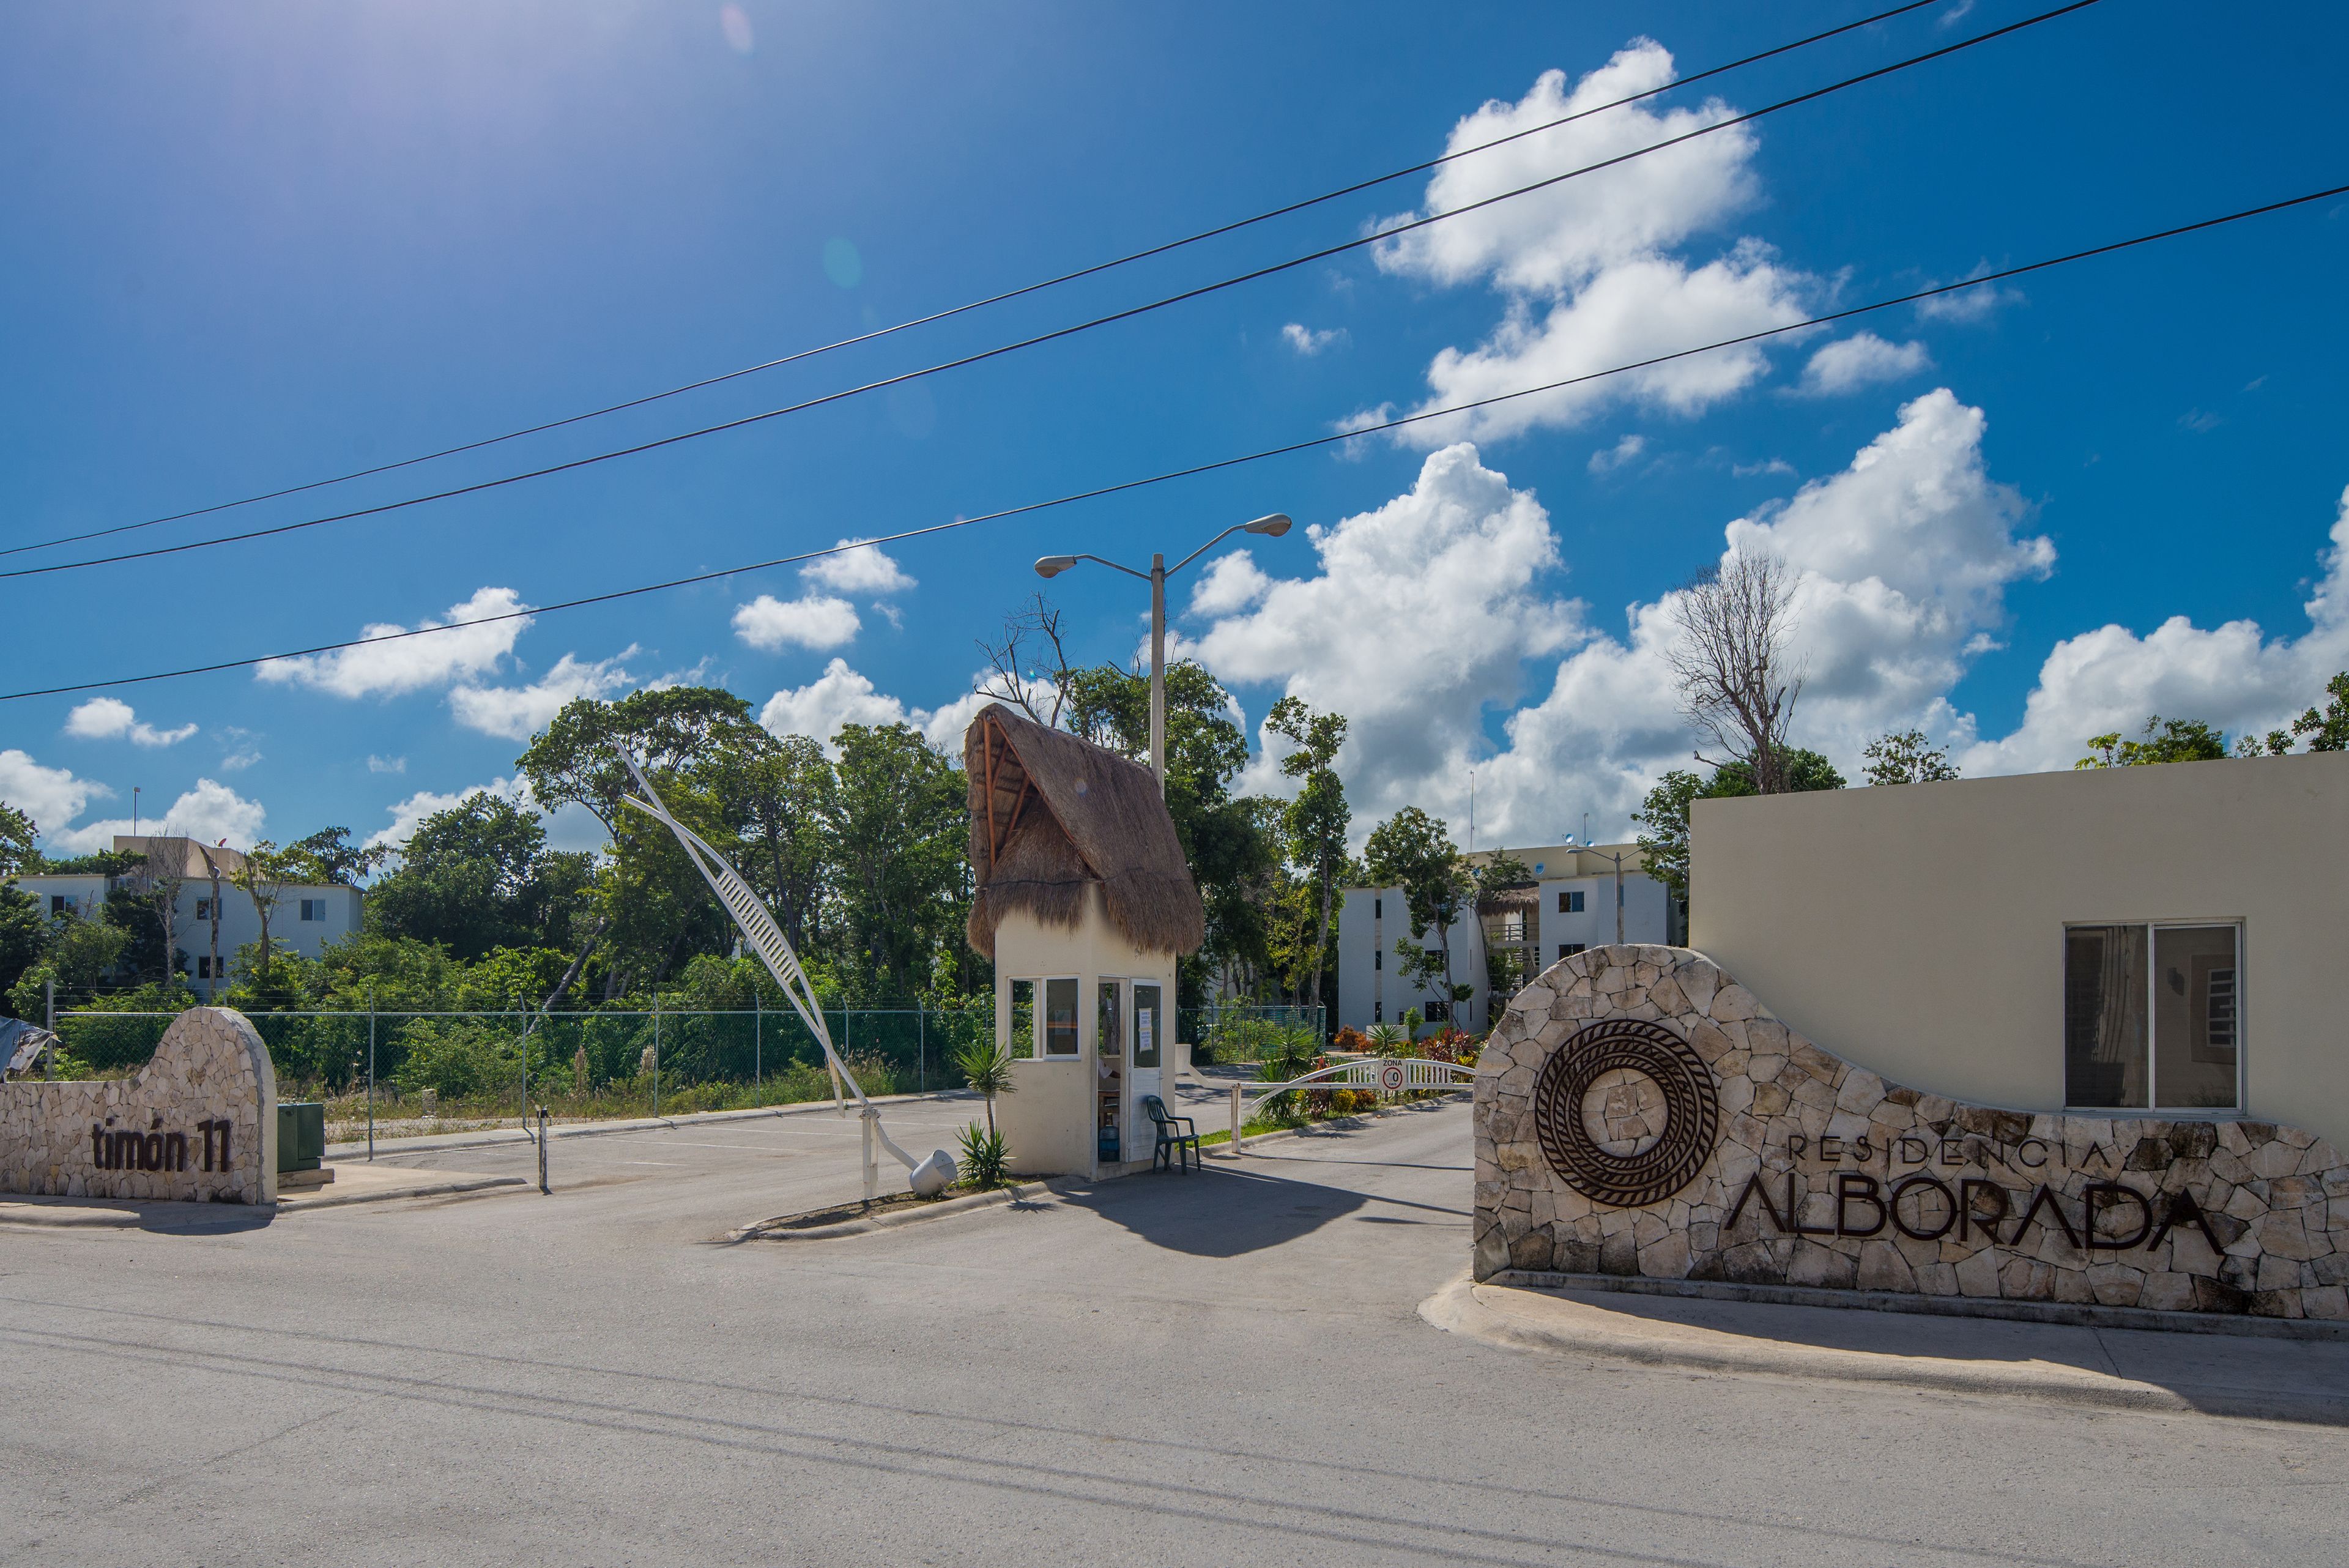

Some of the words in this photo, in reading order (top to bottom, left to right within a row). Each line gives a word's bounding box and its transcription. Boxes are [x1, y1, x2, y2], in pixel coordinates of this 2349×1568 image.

[92, 1118, 184, 1172] timón
[197, 1119, 231, 1172] 11
[1788, 1134, 2112, 1169] RESIDENCIA
[1724, 1171, 2227, 1256] ALBORADA
